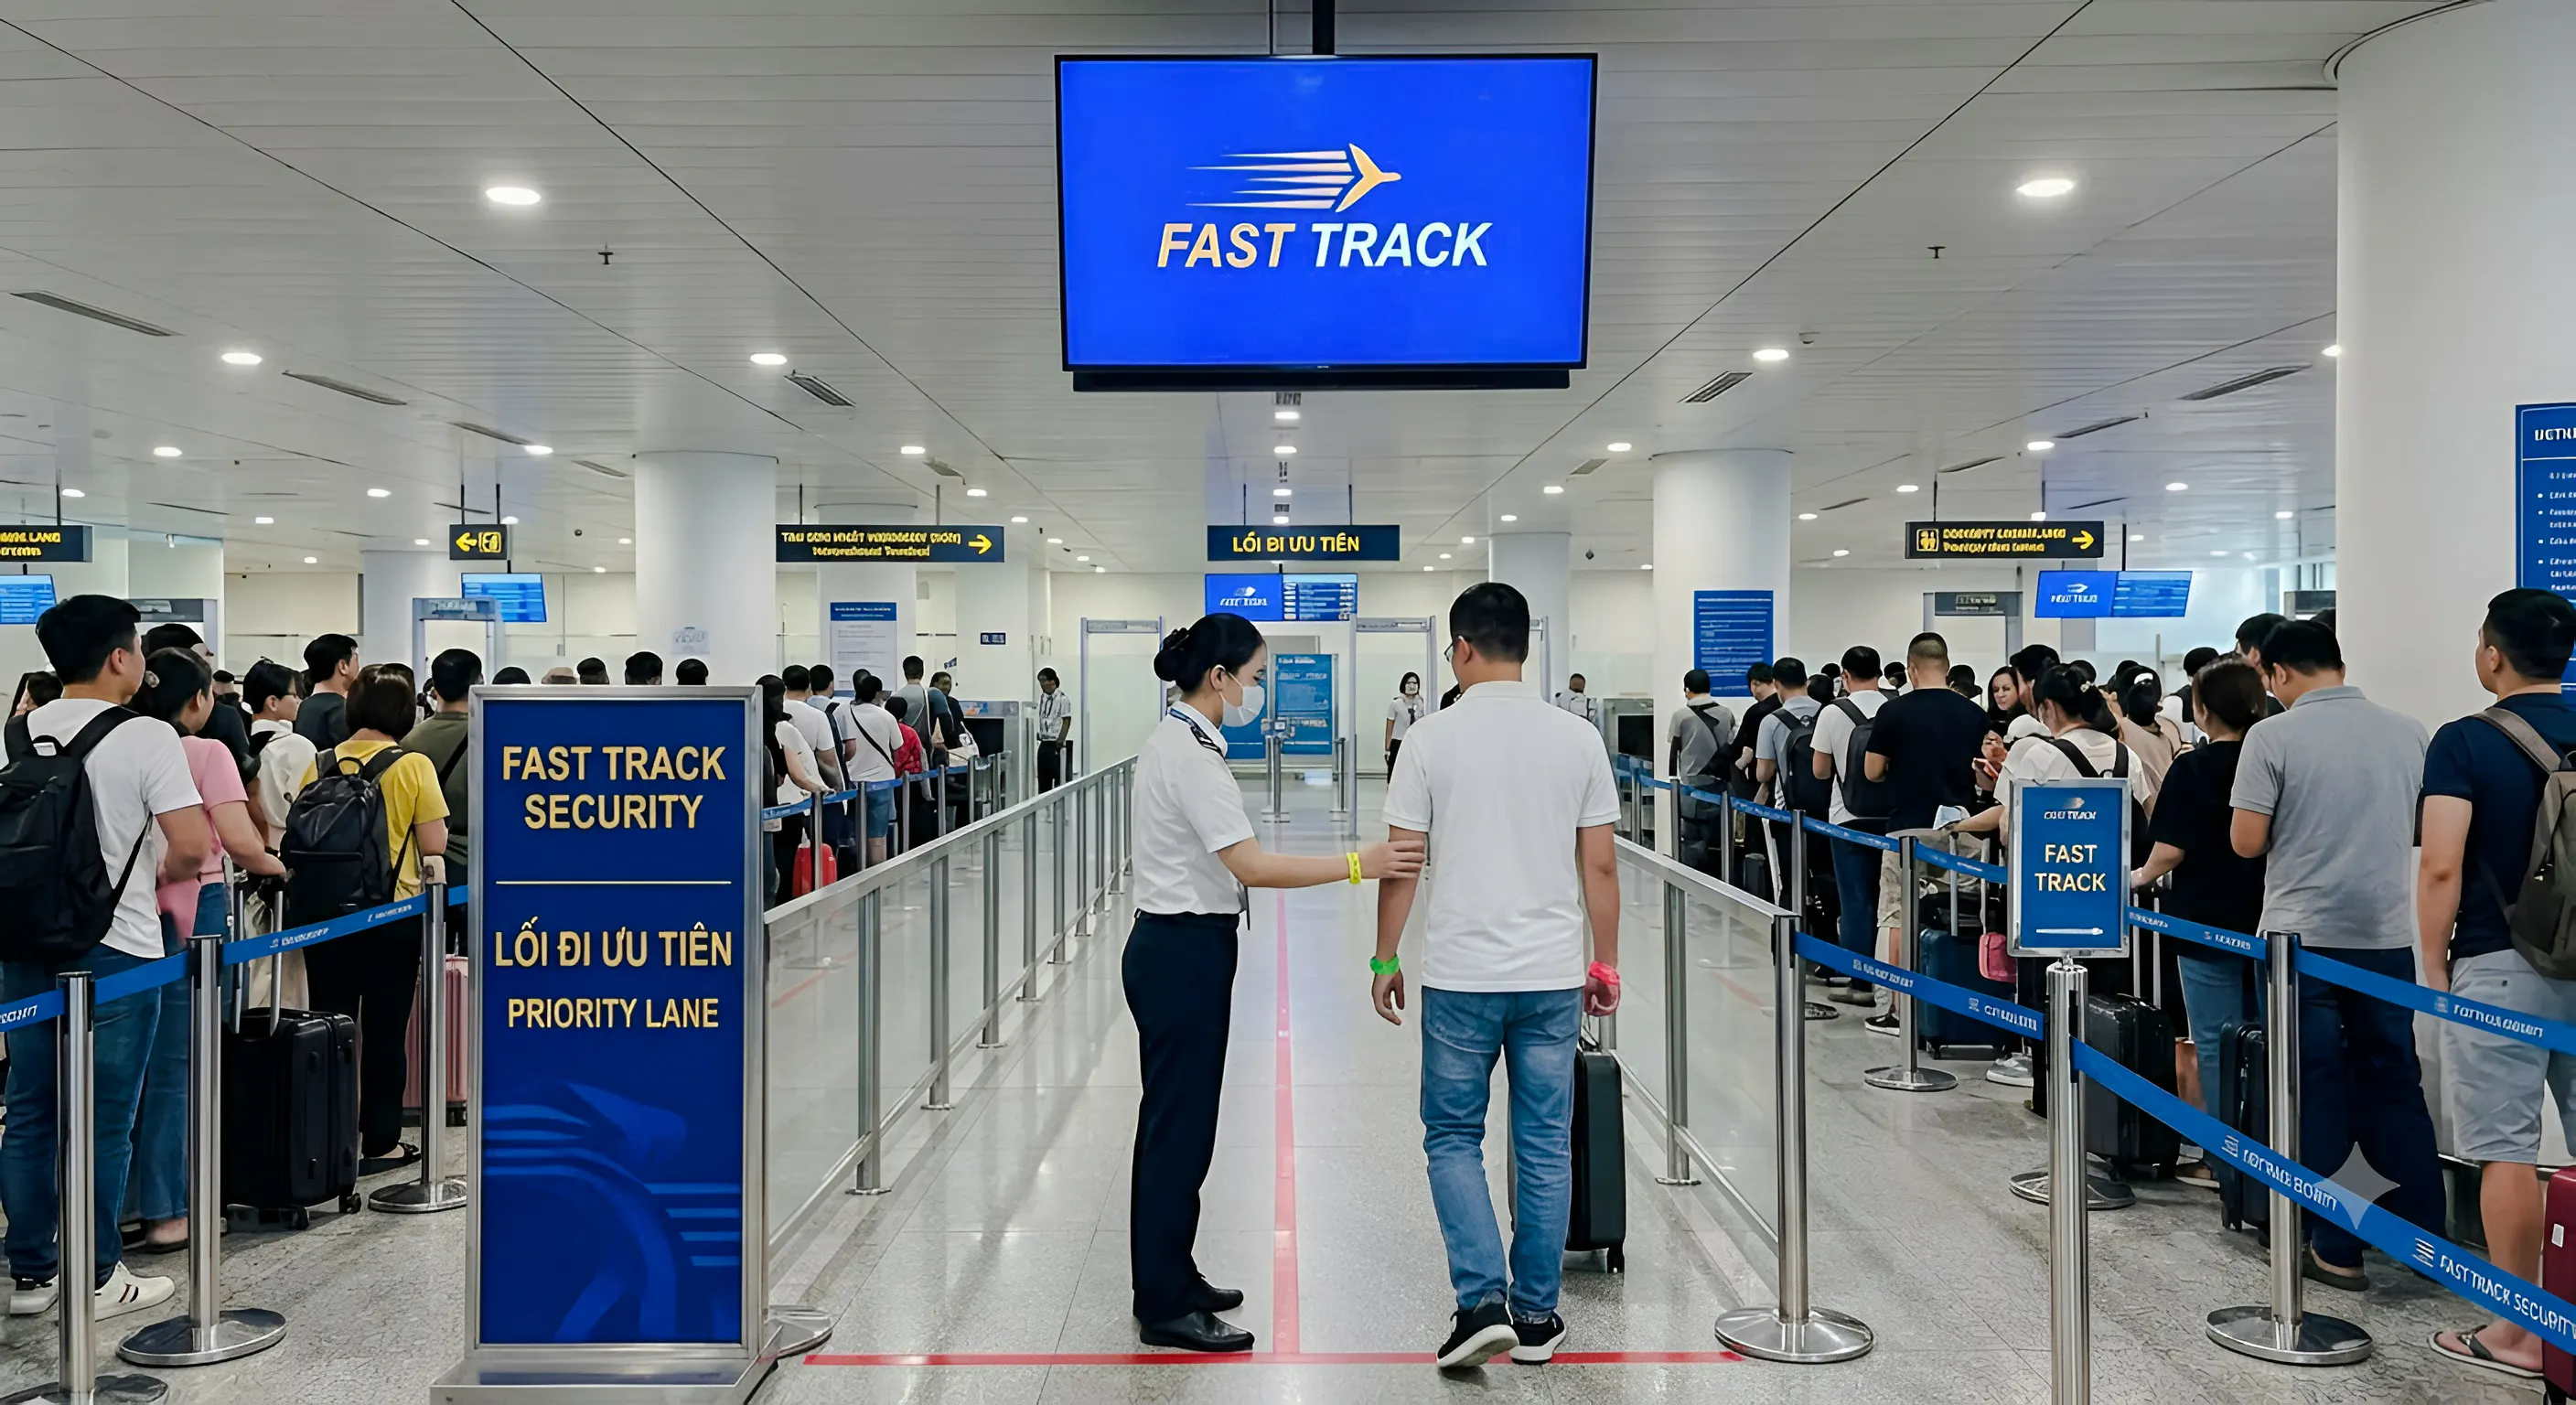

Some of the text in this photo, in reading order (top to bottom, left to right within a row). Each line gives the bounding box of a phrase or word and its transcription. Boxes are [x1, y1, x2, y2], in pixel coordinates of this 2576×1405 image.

[1157, 222, 1493, 269] FAST TRACK
[503, 745, 726, 781] FAST TRACK
[524, 793, 703, 829] SECURITY
[2045, 844, 2098, 863] FAST
[2034, 873, 2107, 892] TRACK
[496, 916, 732, 967] LỐI ĐI ƯU TIÊN
[508, 998, 719, 1028] PRIORITY LANE
